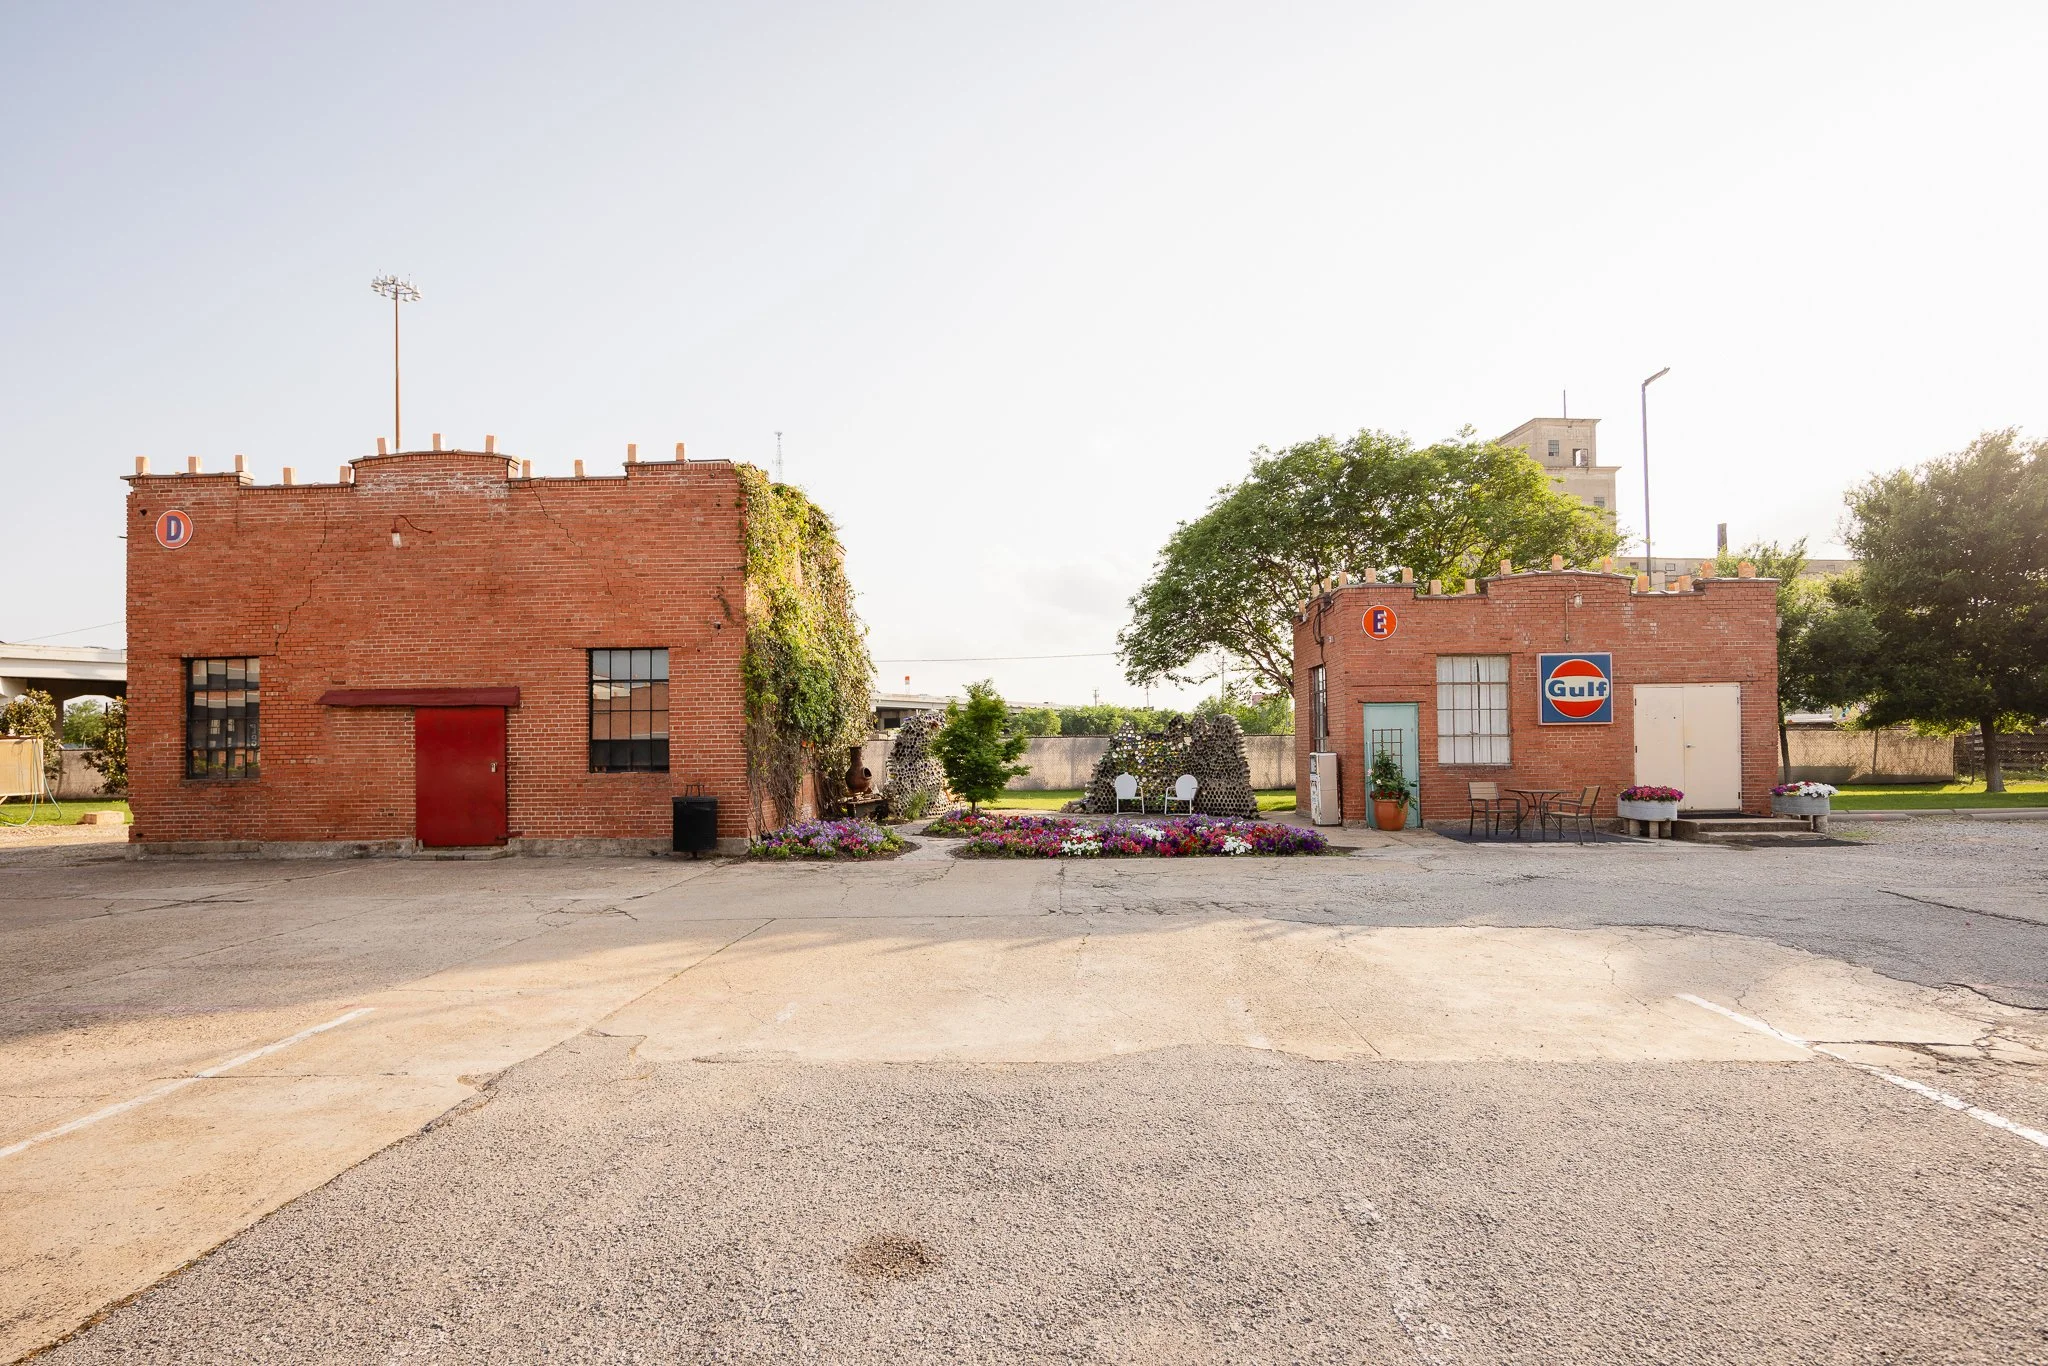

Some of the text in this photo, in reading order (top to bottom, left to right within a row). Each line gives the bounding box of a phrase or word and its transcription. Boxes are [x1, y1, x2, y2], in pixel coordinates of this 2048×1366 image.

[166, 515, 185, 543] D
[1373, 609, 1388, 635] E
[1547, 679, 1607, 697] Gulf
